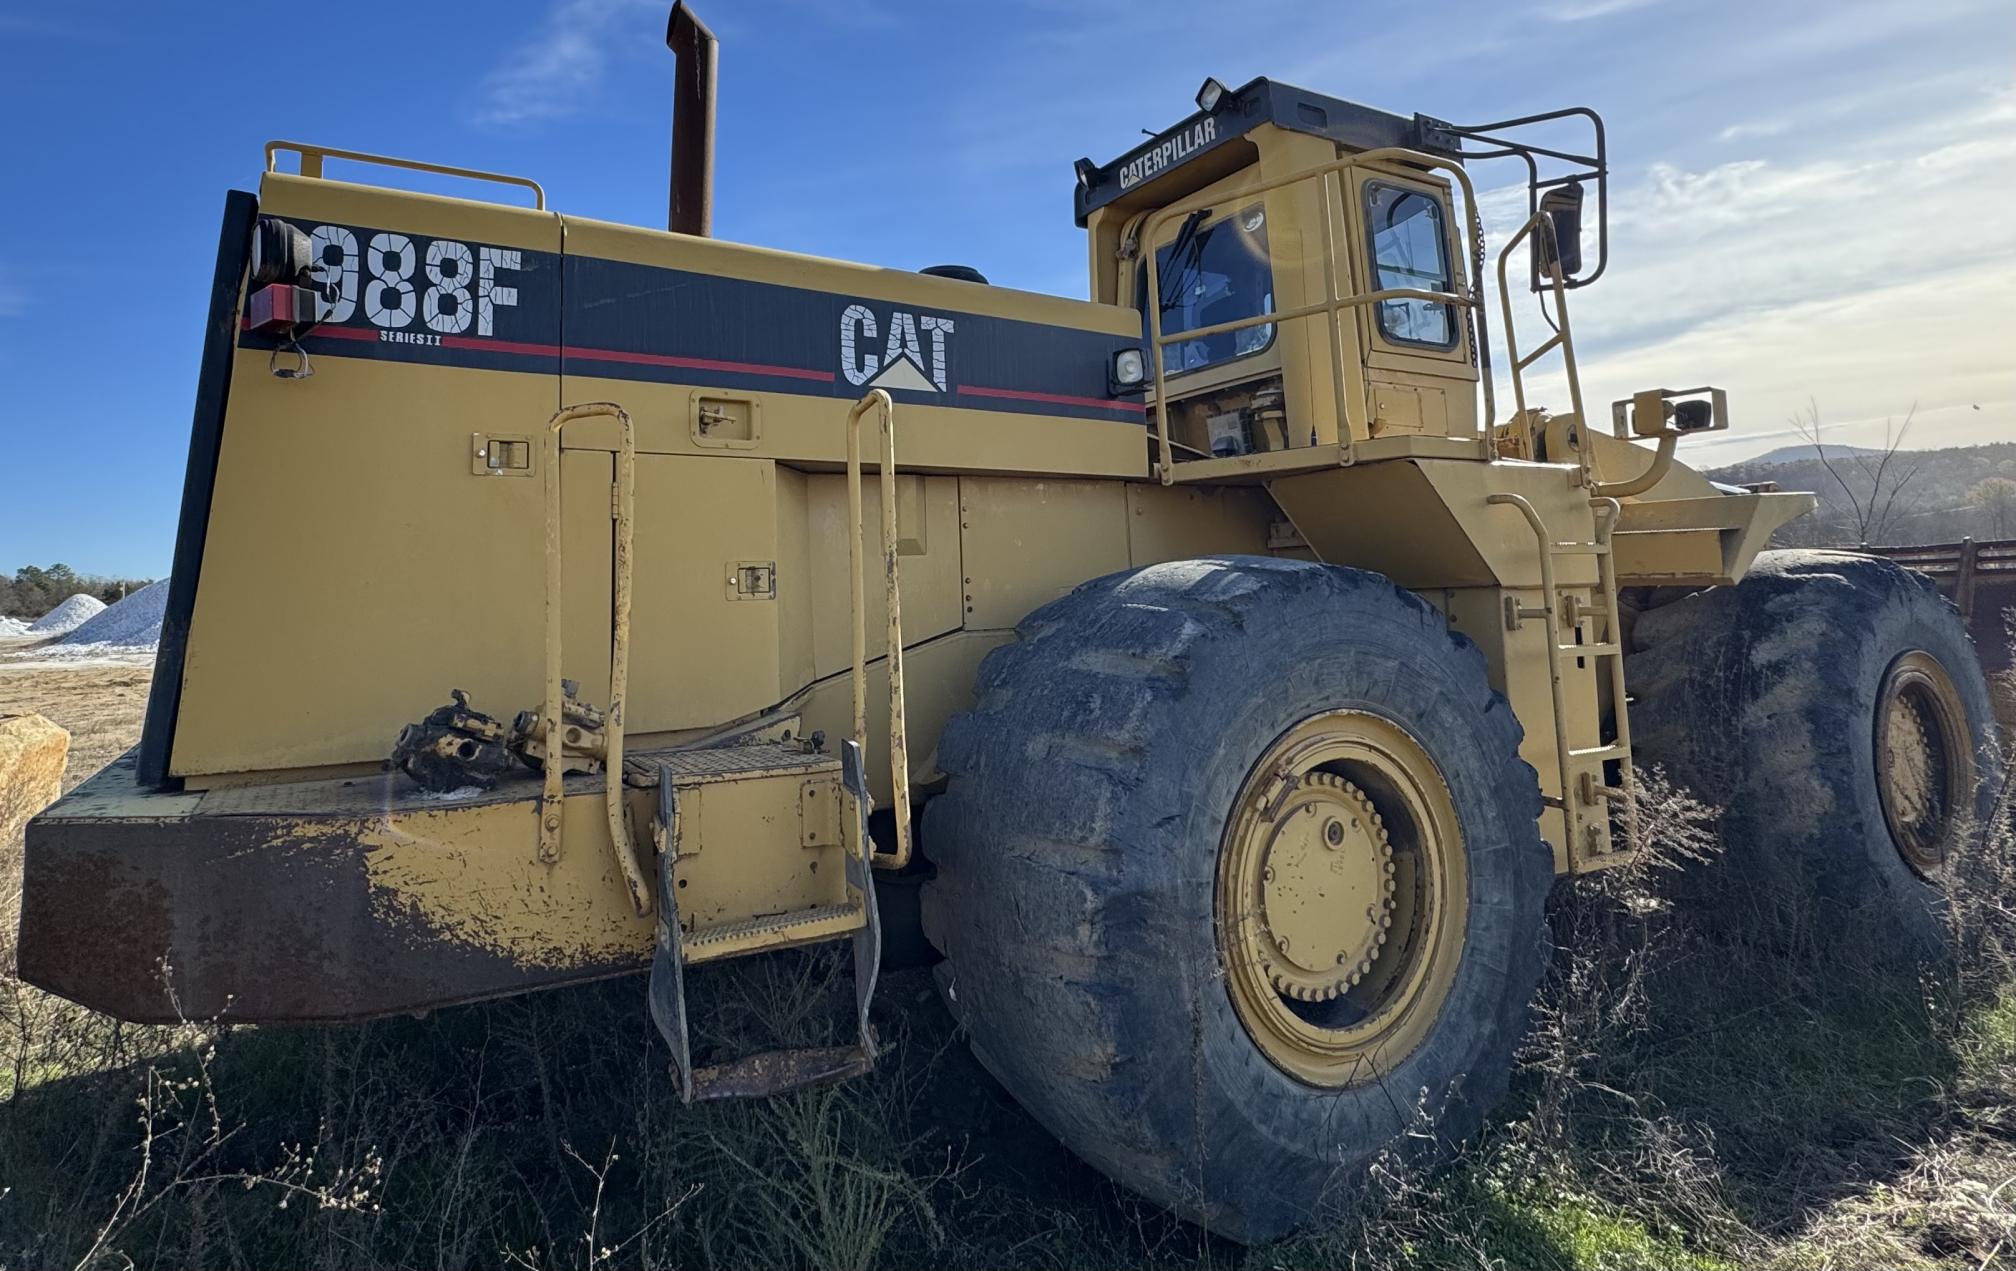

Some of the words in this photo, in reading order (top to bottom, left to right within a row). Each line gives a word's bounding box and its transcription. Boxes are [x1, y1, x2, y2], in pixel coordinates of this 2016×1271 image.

[1119, 117, 1216, 189] CATERPILLAR
[311, 225, 521, 337] 988F
[840, 304, 955, 392] CAT
